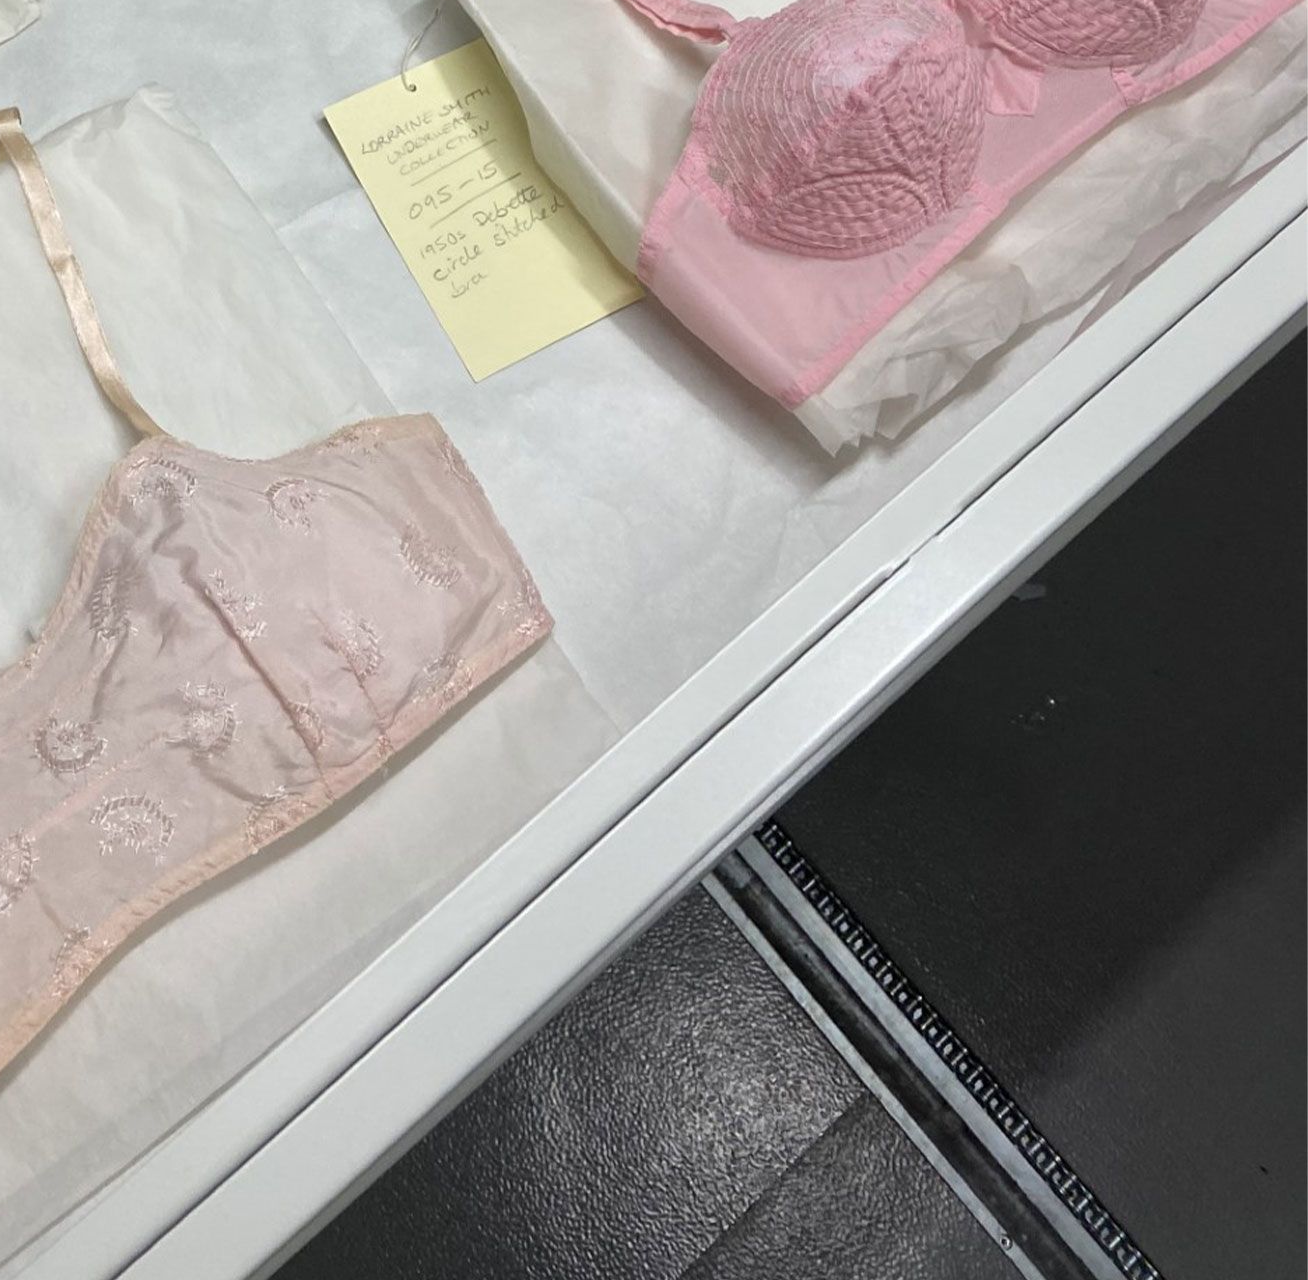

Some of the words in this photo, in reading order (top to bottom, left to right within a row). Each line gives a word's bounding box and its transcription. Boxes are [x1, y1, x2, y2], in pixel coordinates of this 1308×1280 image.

[360, 111, 433, 156] LORRAINE
[387, 111, 480, 166] UNDERWEAR
[399, 120, 490, 176] COLLECTION
[450, 270, 488, 299] bra
